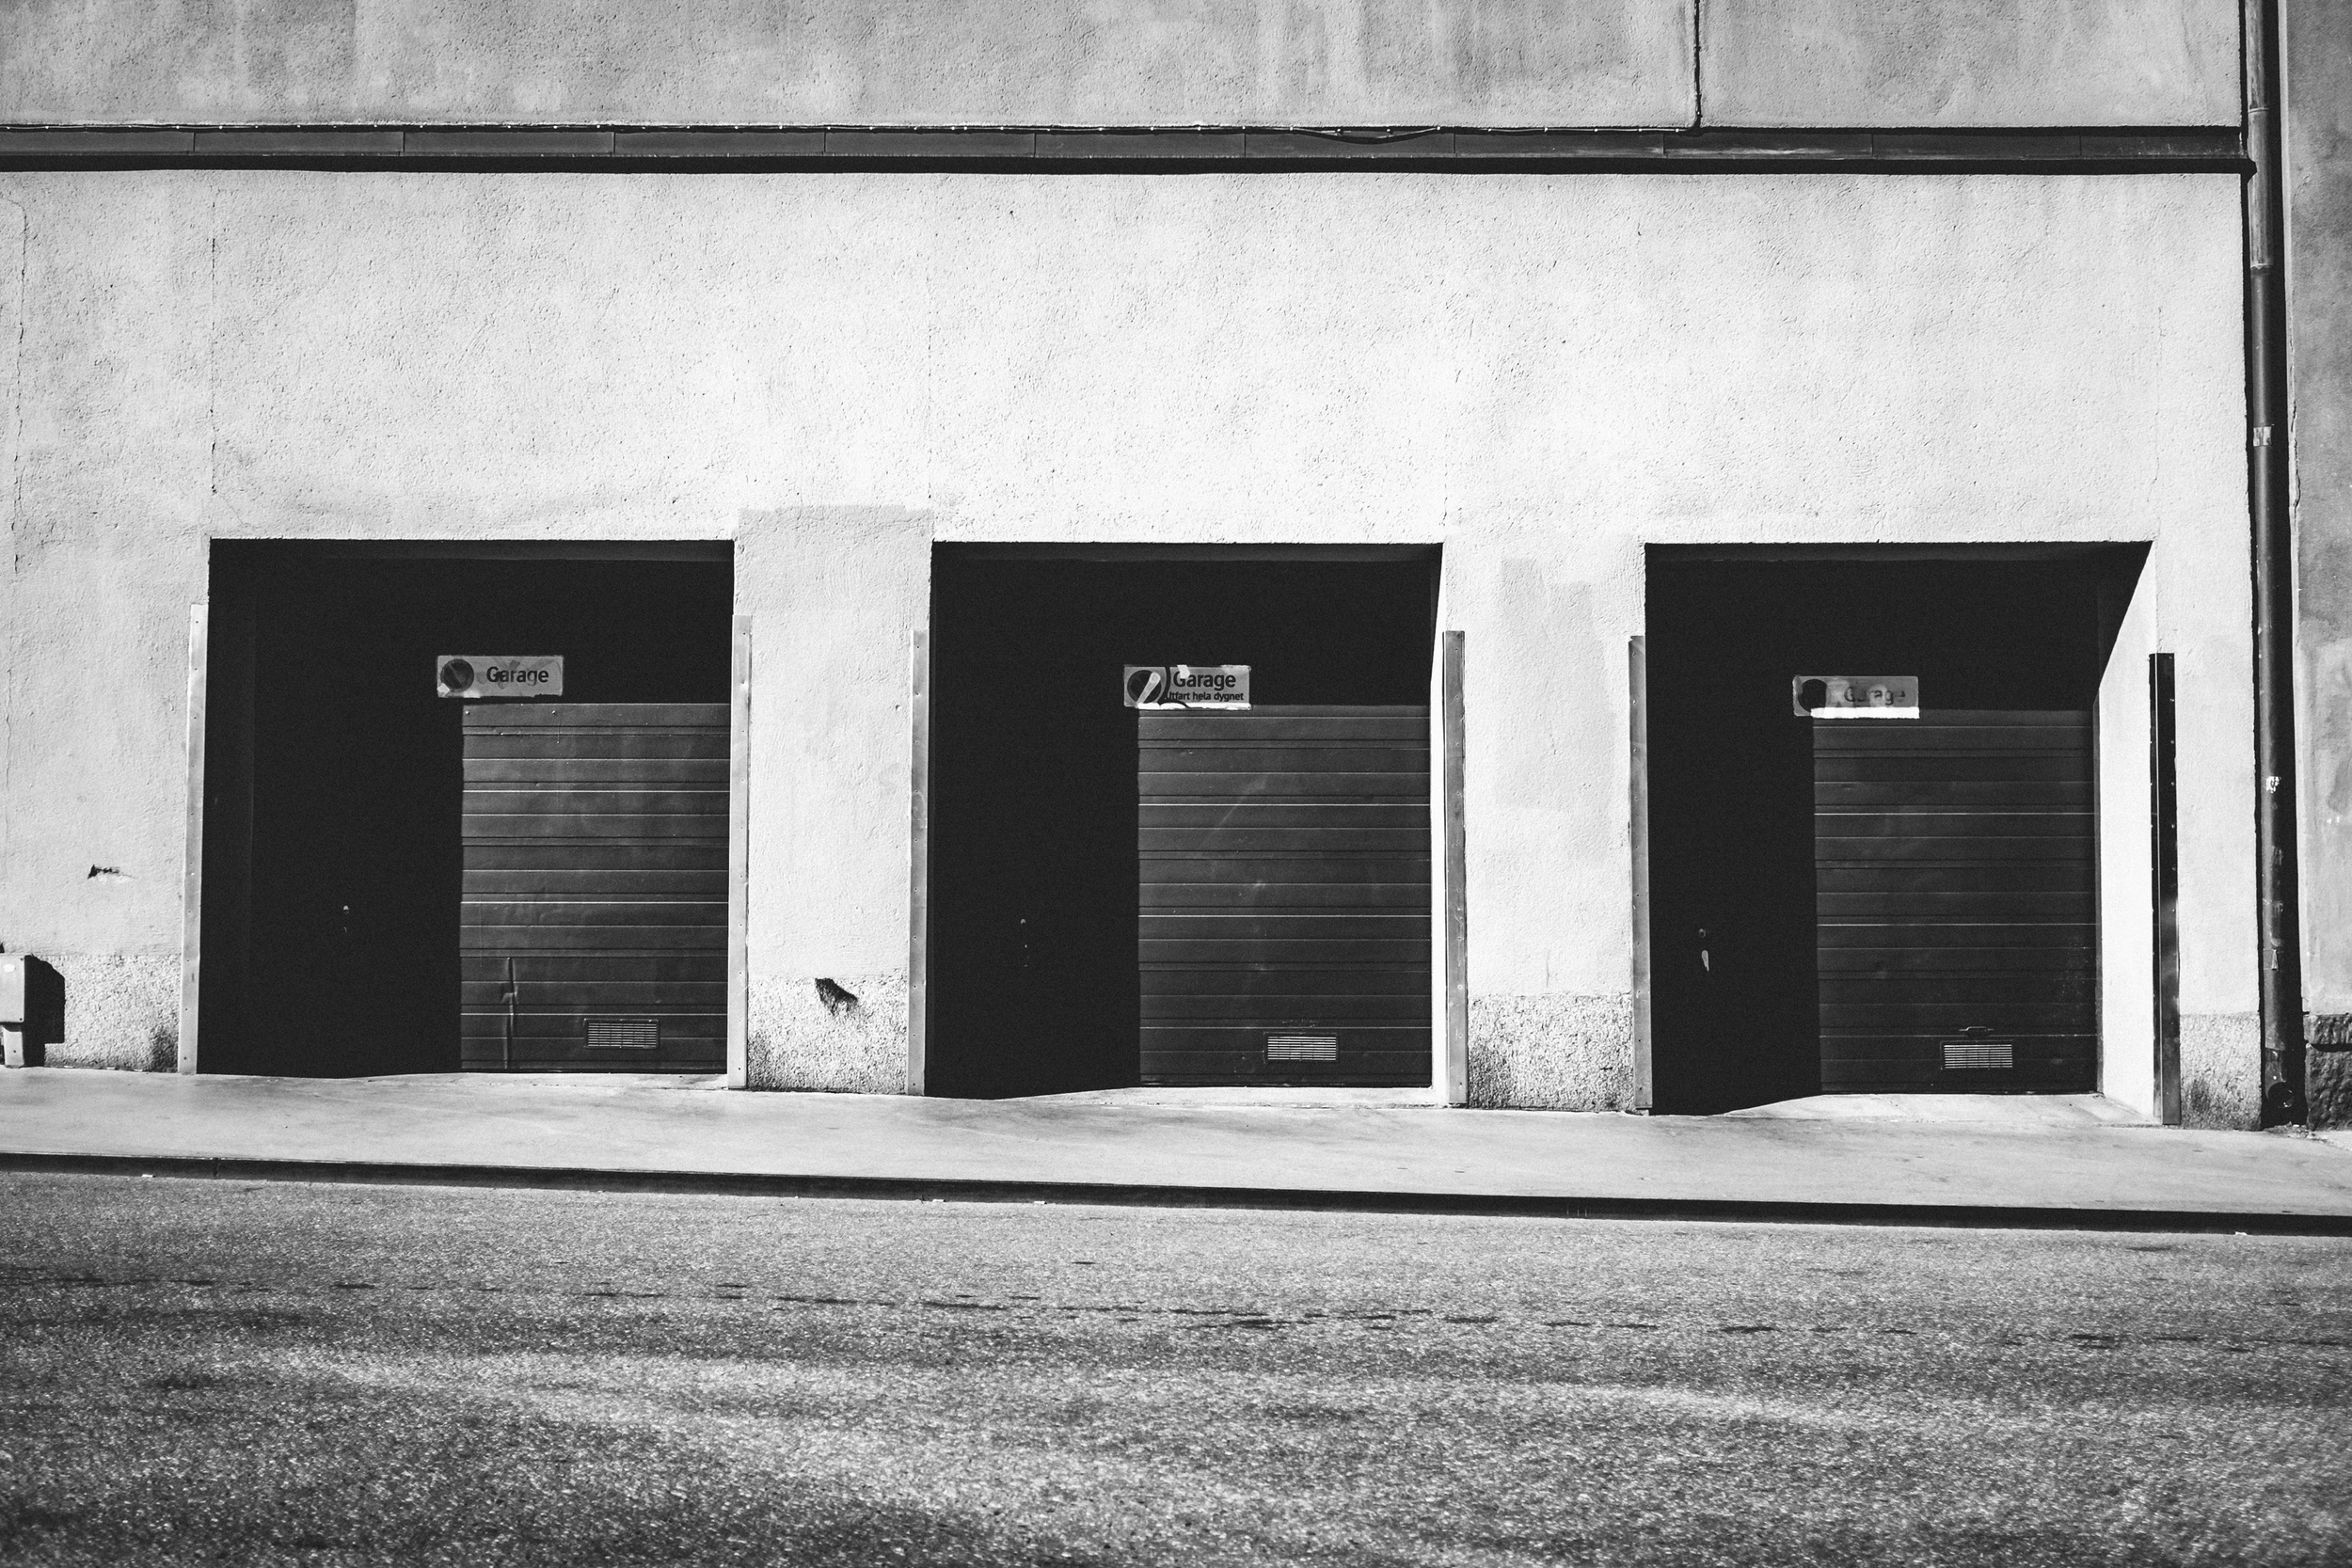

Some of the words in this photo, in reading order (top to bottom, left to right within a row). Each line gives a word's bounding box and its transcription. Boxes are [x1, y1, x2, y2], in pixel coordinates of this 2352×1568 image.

[486, 666, 549, 687] Garage
[1173, 671, 1236, 691] Garage
[1192, 690, 1212, 701] hela
[1214, 690, 1244, 703] dygnet
